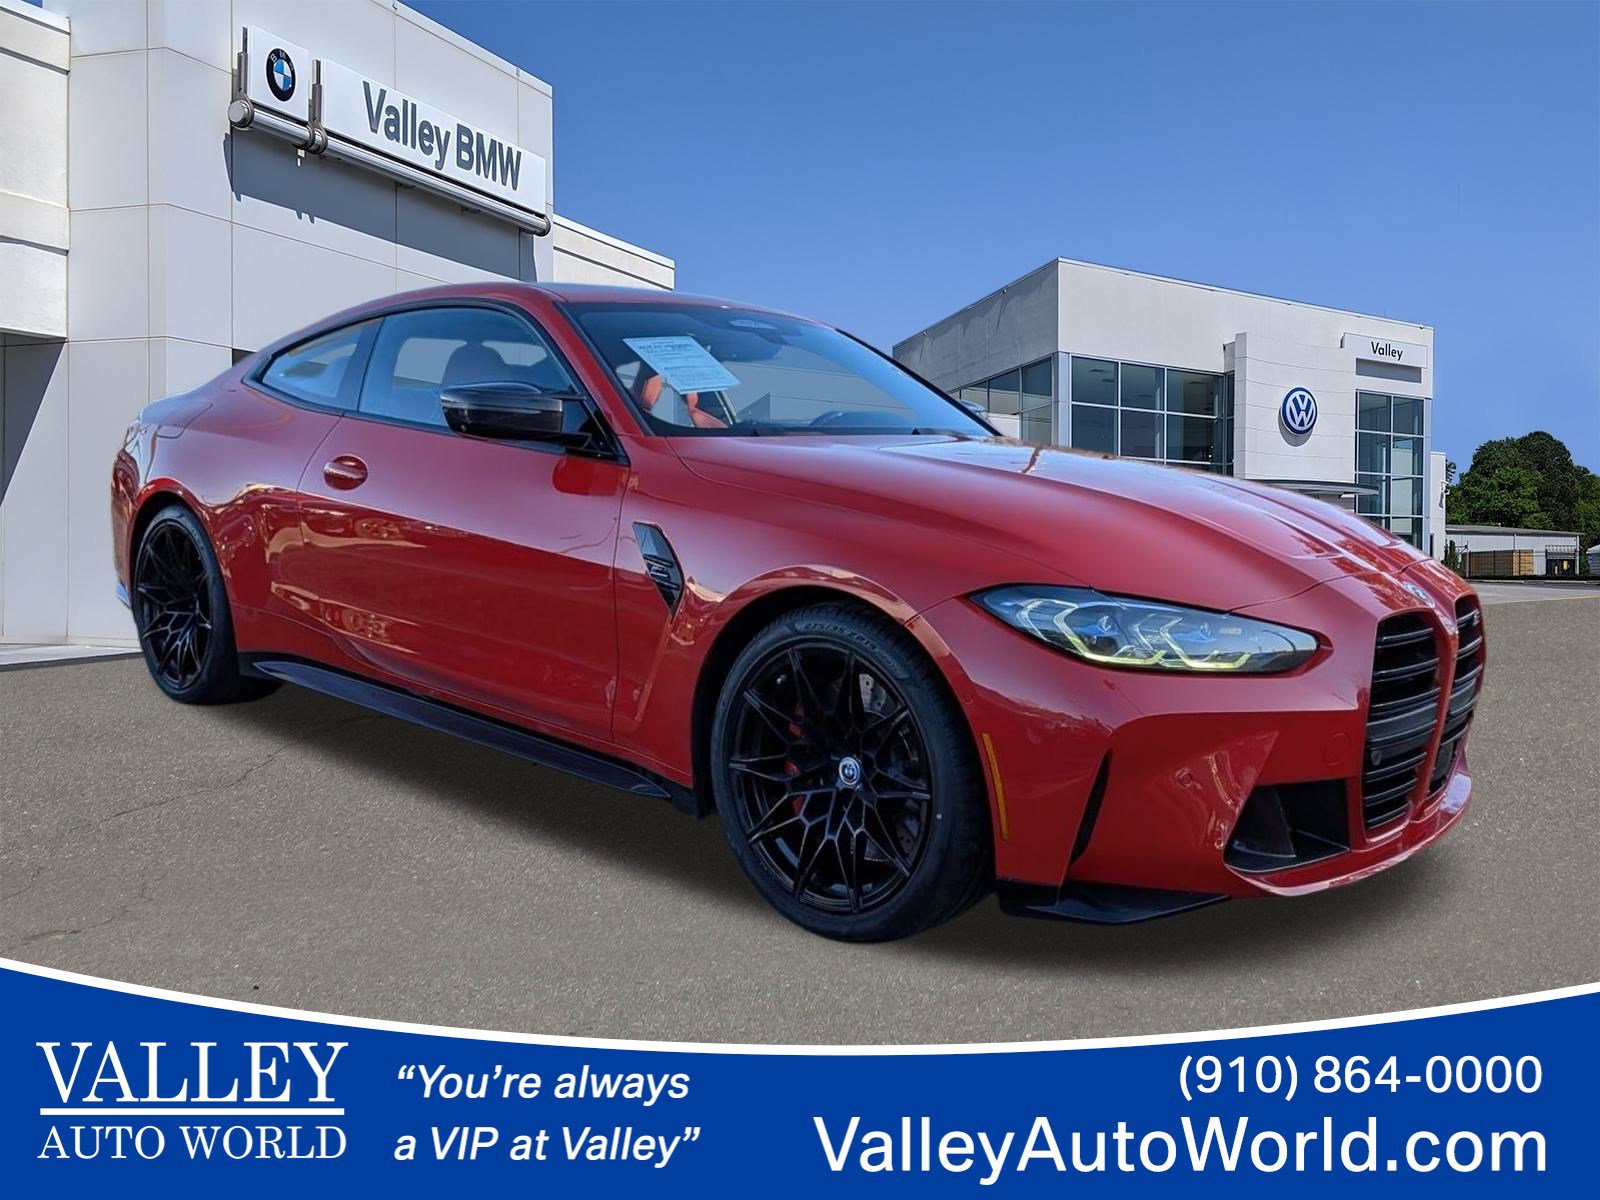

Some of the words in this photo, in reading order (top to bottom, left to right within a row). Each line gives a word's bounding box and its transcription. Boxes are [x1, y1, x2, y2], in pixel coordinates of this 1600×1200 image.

[362, 80, 451, 171] Valley
[456, 123, 522, 191] BMW
[1371, 341, 1403, 361] Valley
